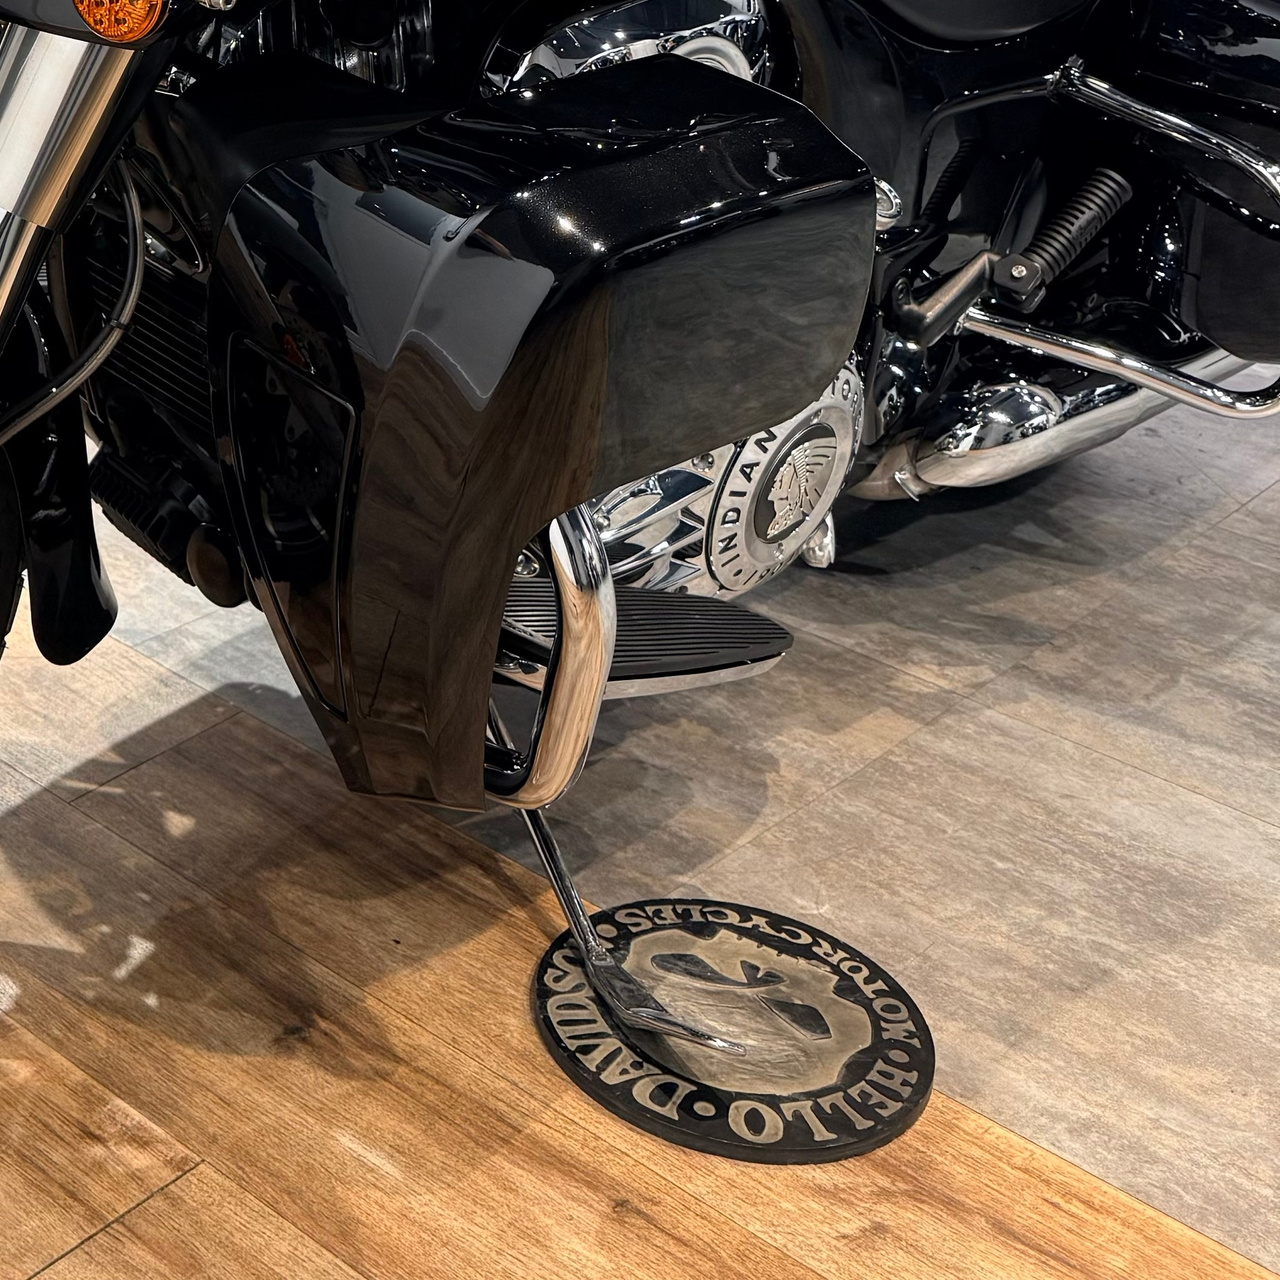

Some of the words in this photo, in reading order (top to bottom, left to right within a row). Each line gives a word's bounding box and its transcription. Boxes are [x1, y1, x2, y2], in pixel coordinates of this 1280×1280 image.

[717, 427, 778, 568] INDIAN
[543, 944, 698, 1122] DAVIDS
[727, 1058, 920, 1145] HELLO
